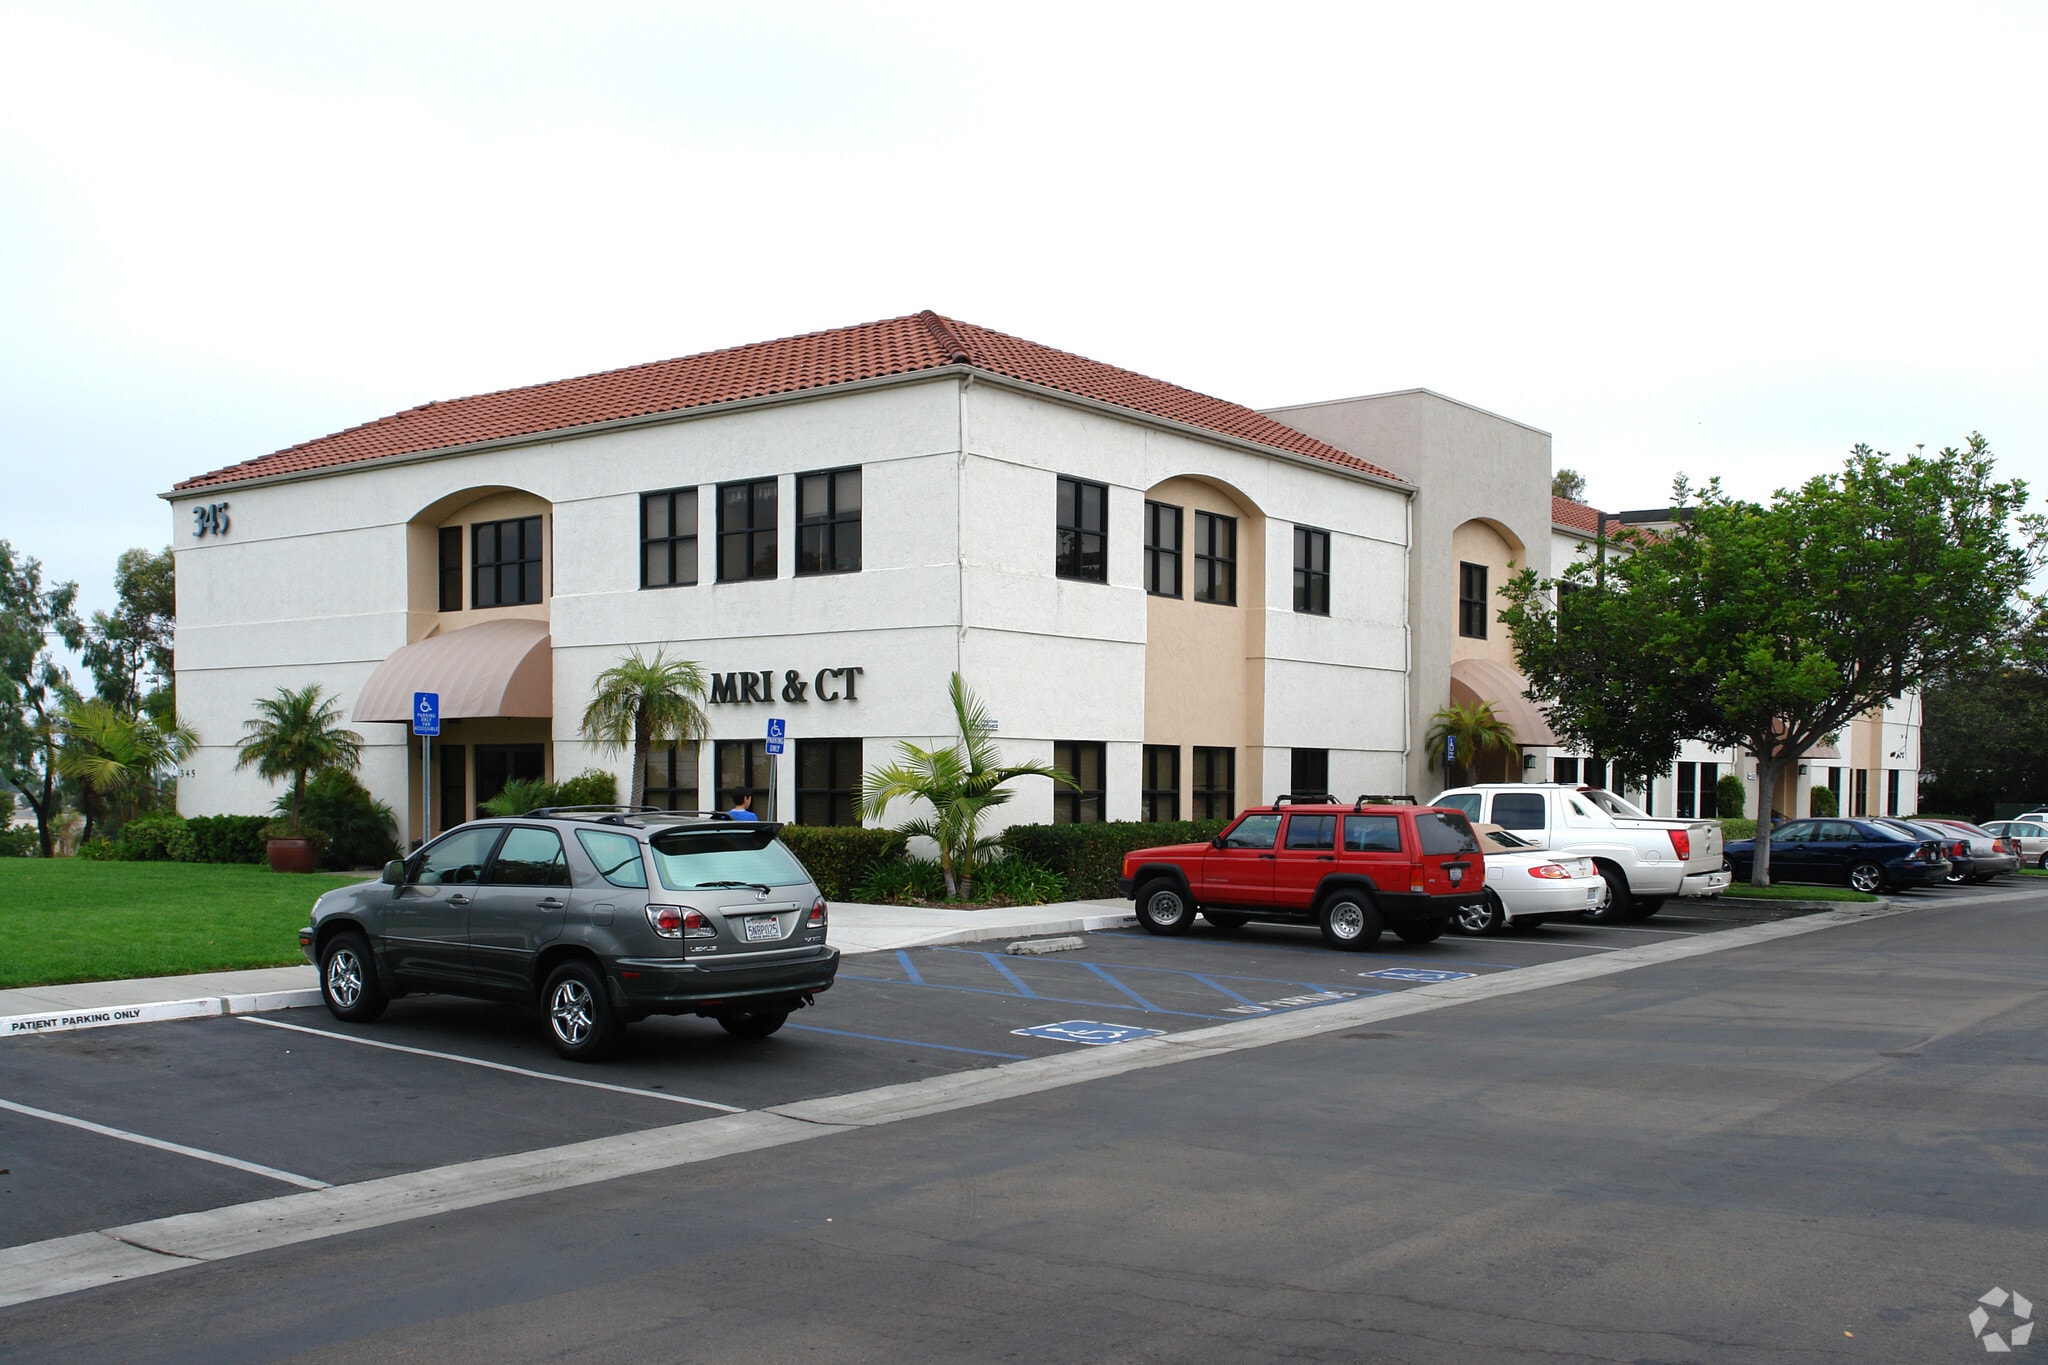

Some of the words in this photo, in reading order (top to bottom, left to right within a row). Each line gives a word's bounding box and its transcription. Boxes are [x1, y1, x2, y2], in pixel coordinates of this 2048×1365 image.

[192, 502, 231, 537] 345
[709, 670, 775, 703] MRI
[782, 669, 808, 702] &
[814, 666, 863, 701] CT
[180, 769, 196, 778] 345
[12, 1018, 58, 1031] PATIENT
[62, 1013, 110, 1026] PARKING
[114, 1010, 140, 1020] ONLY
